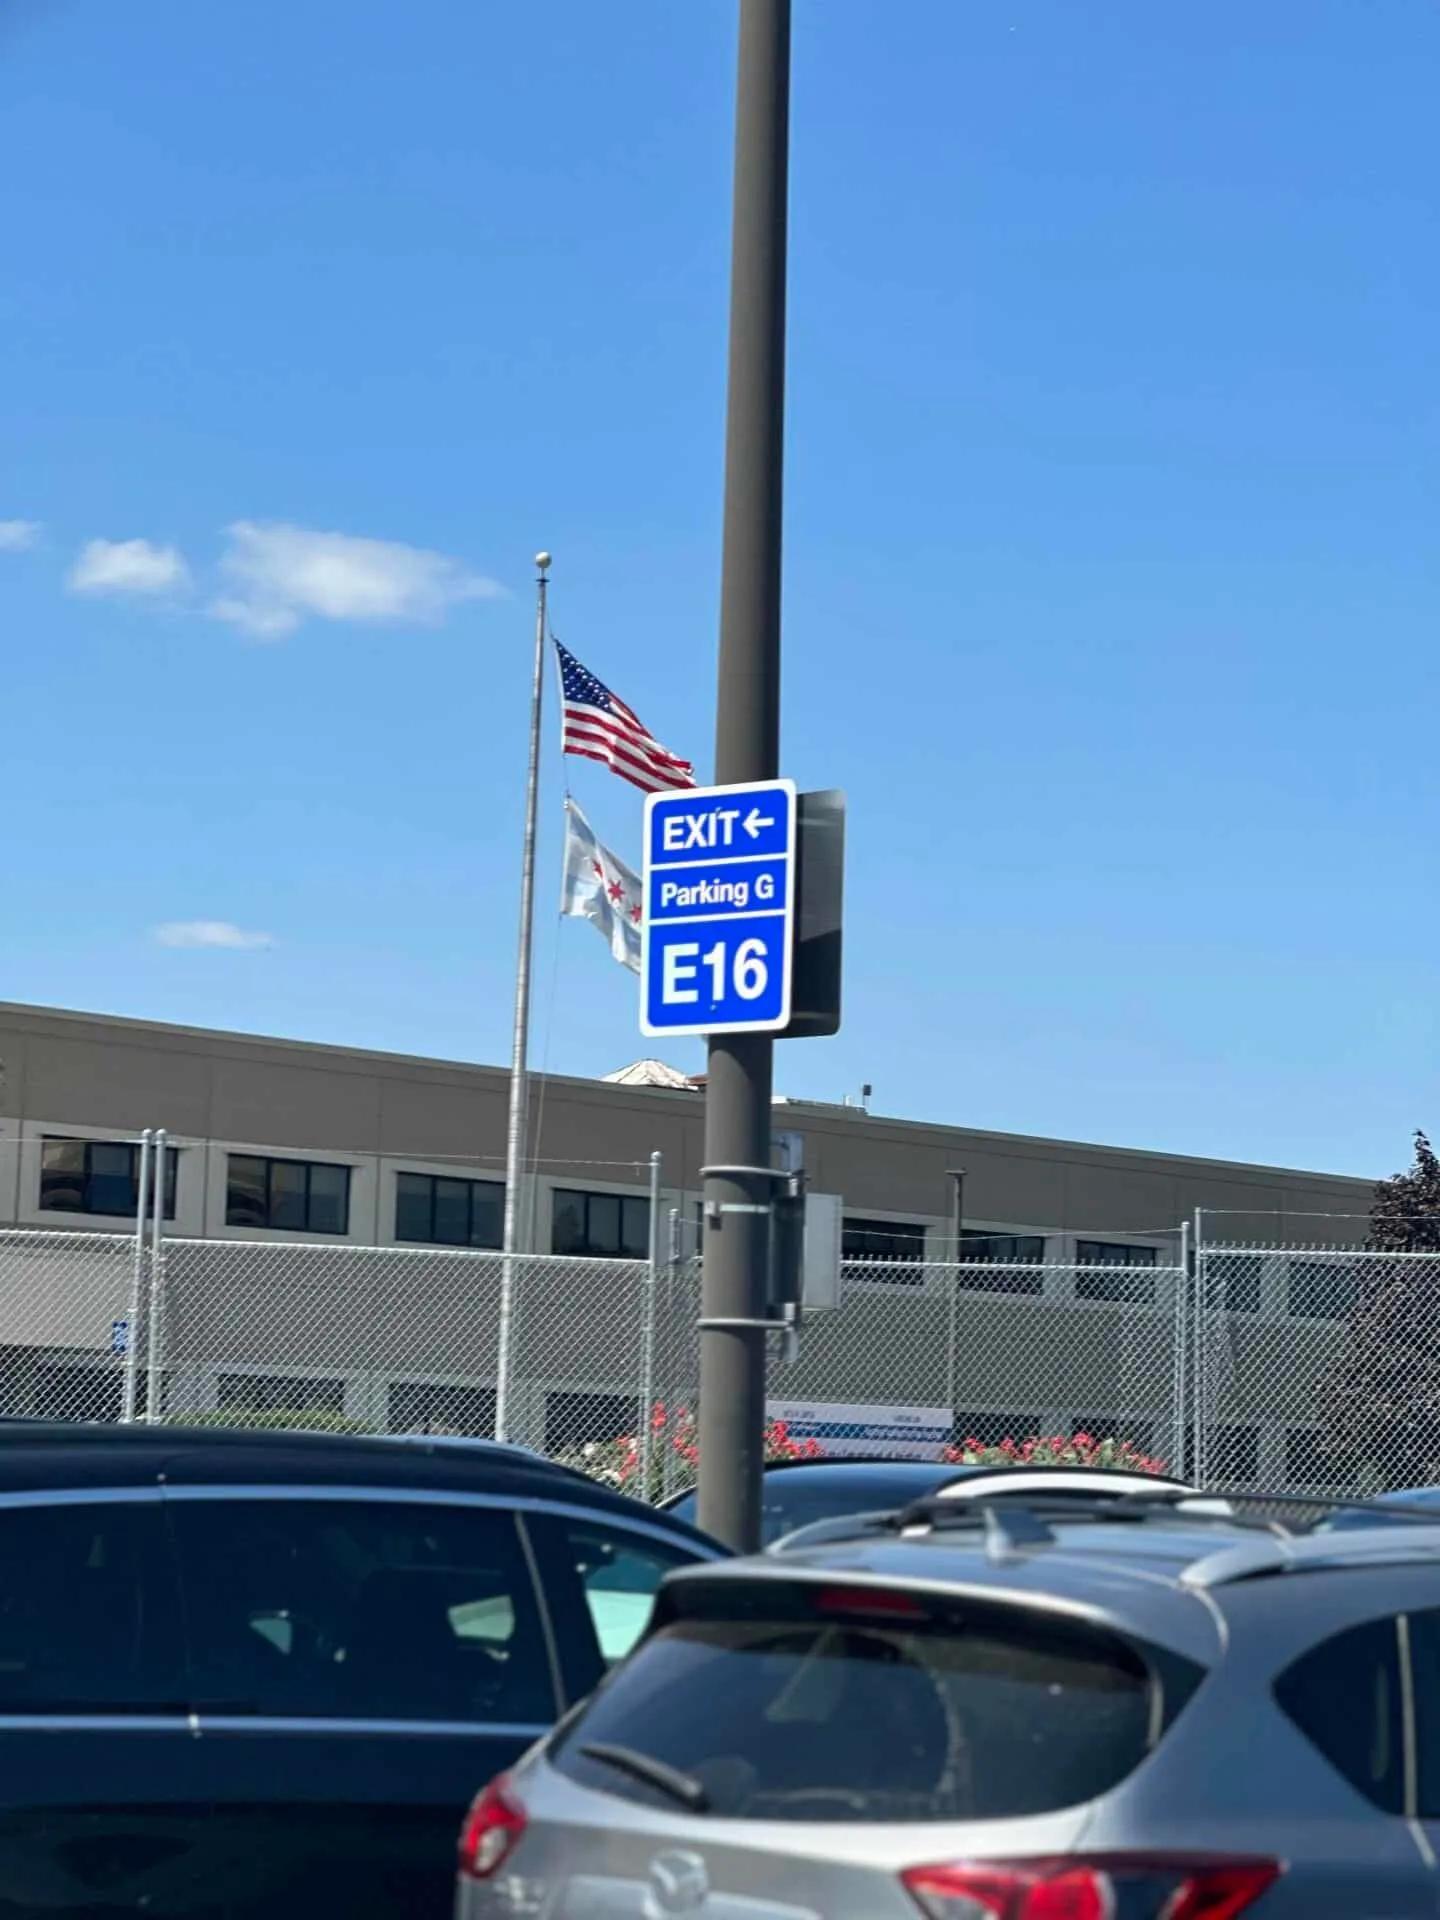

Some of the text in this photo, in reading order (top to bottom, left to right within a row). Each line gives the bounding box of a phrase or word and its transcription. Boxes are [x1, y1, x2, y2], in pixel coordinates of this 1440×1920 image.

[663, 810, 740, 850] EXIT
[661, 874, 774, 907] Parking G
[662, 938, 768, 1004] E16
